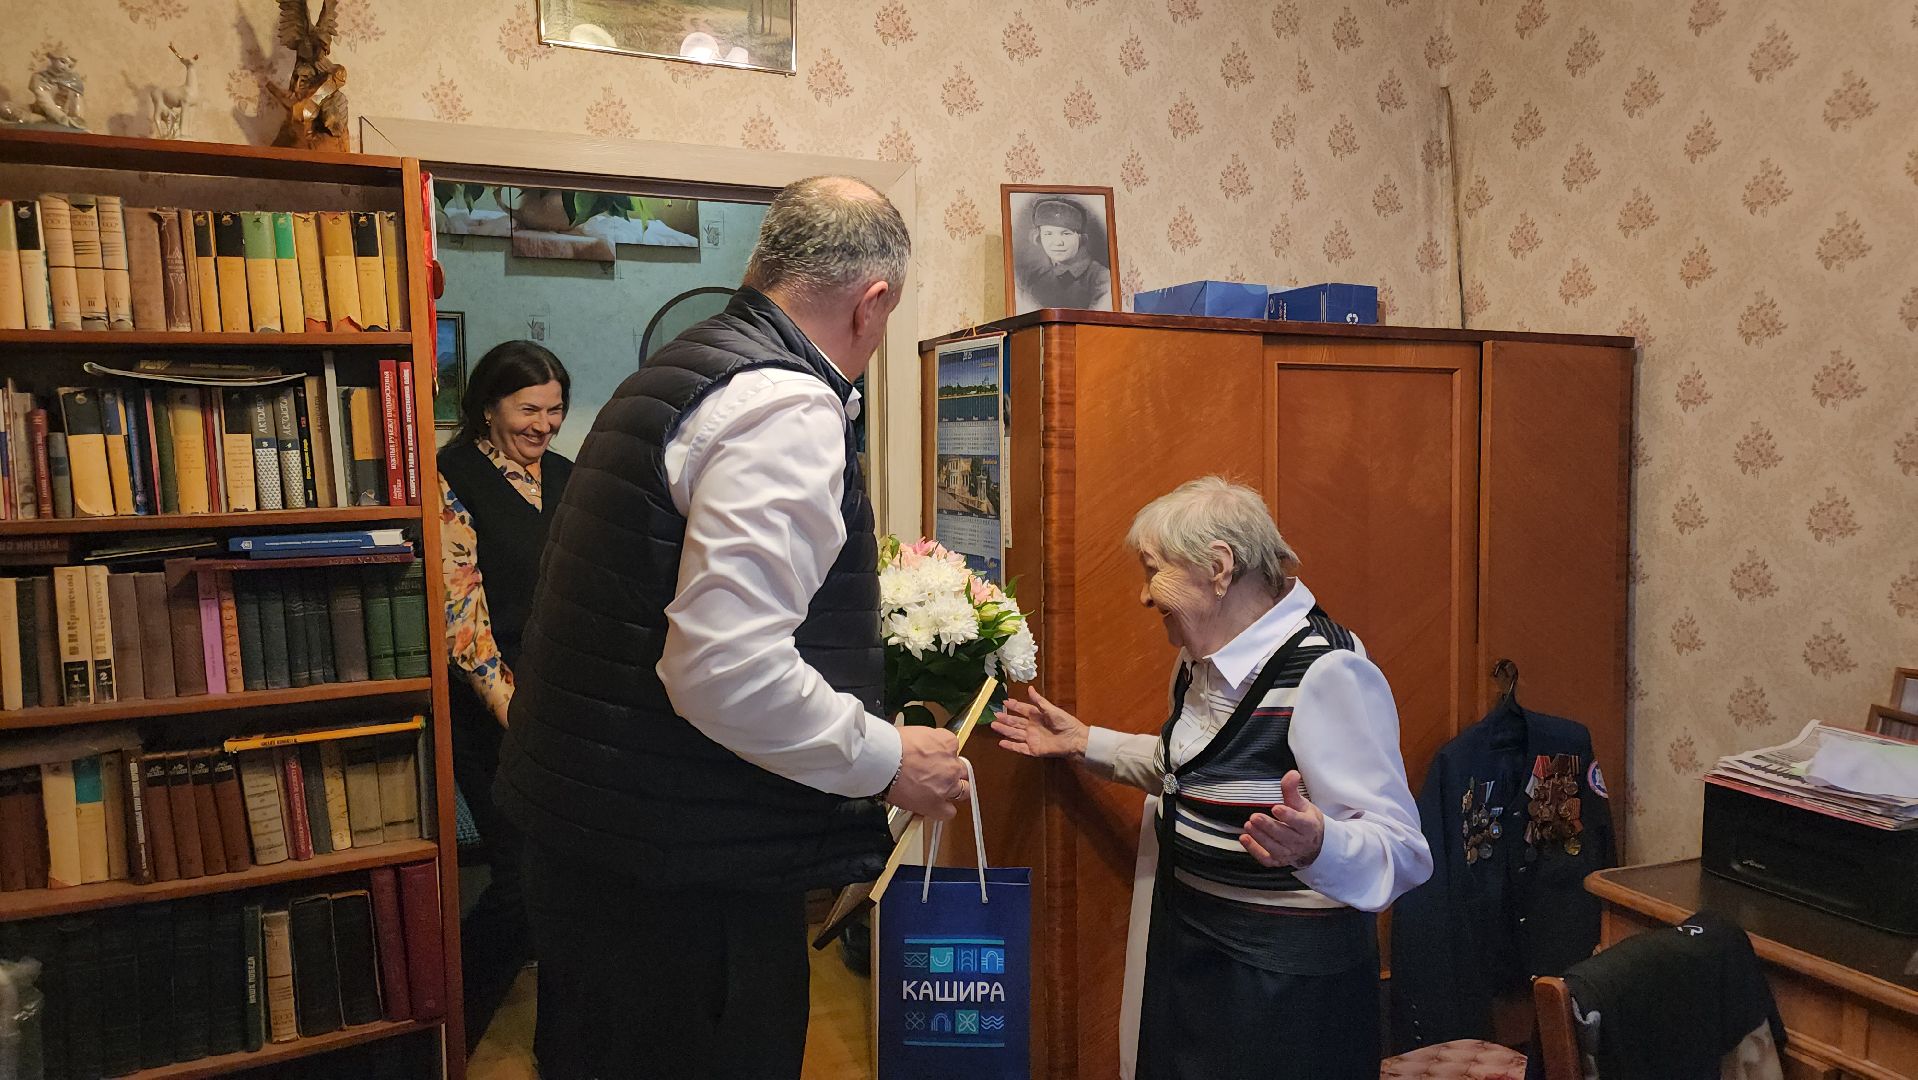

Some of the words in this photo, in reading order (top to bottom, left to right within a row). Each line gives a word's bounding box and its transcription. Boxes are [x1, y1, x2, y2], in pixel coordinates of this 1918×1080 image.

[73, 673, 80, 682] 1
[99, 671, 108, 681] 2
[902, 980, 1006, 1002] КАШИРА
